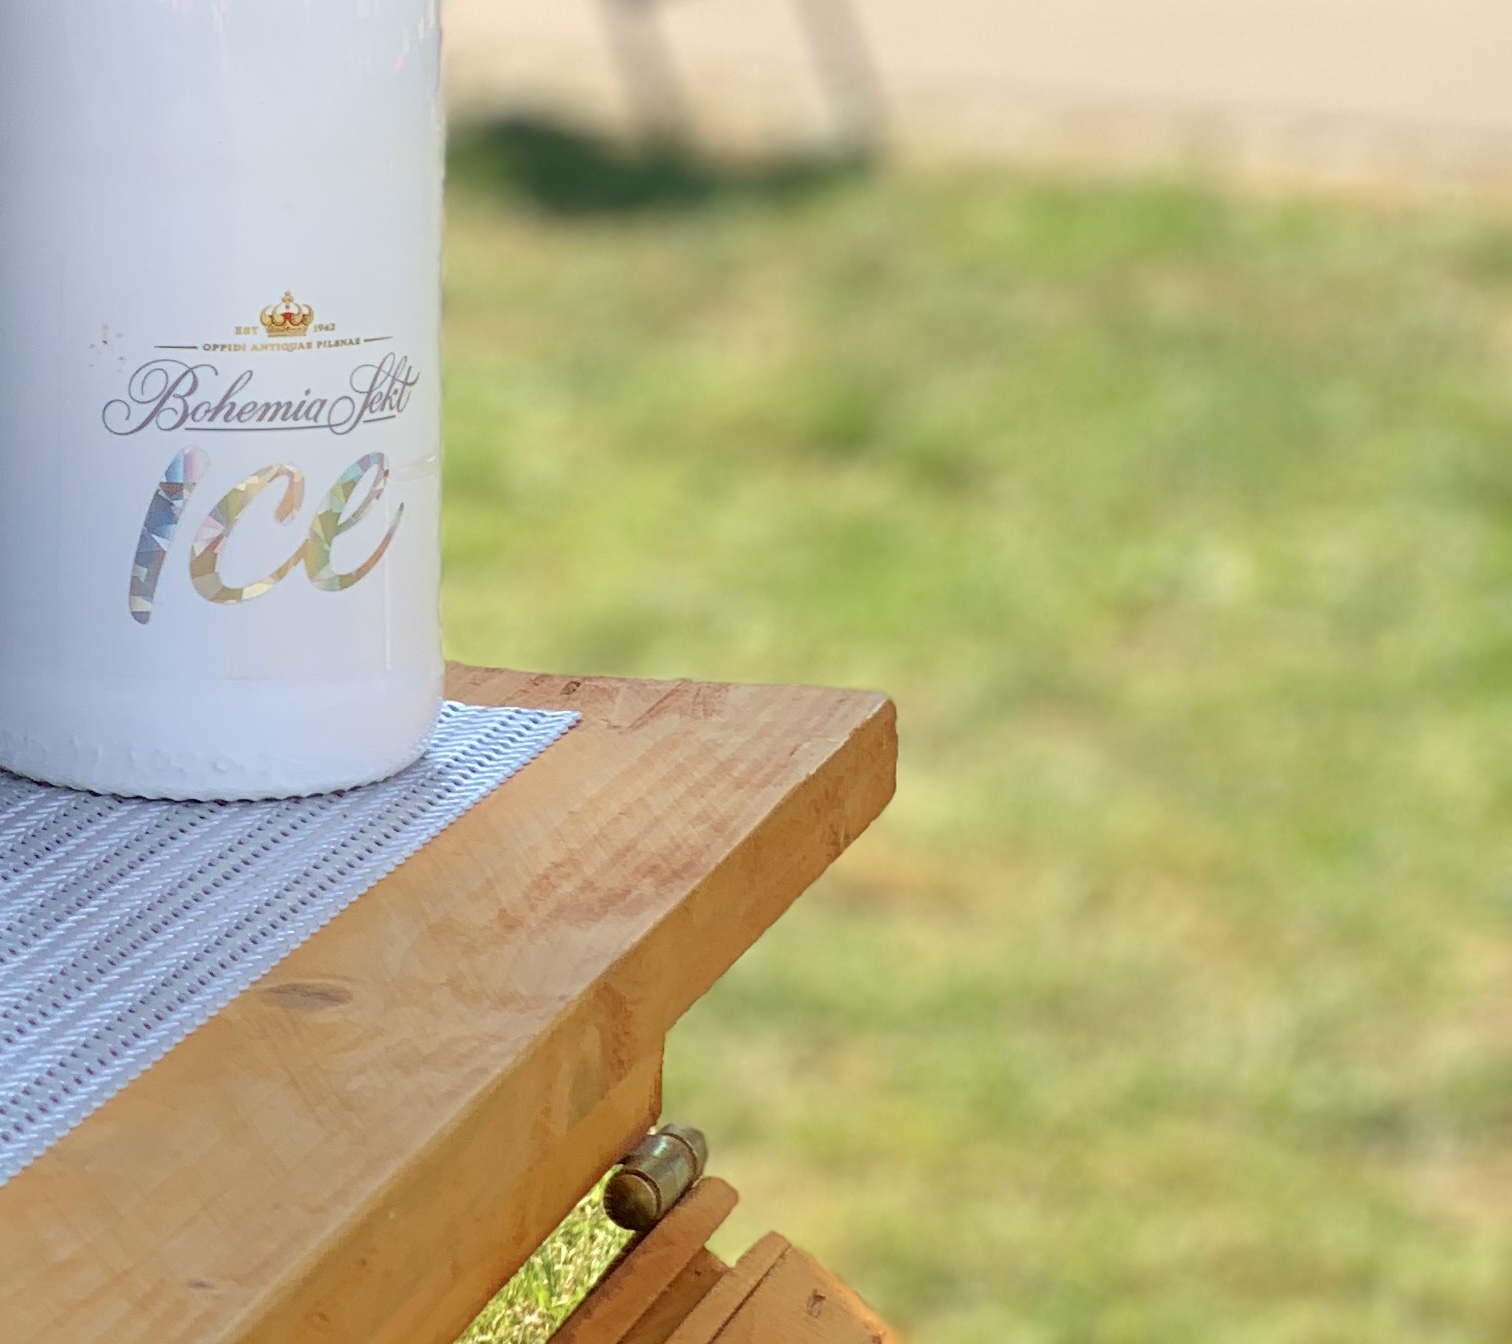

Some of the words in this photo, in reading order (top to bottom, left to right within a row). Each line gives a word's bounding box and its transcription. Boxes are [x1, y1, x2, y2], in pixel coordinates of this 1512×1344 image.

[235, 326, 259, 335] EST
[202, 343, 247, 352] OPPIDI
[102, 359, 327, 435] Bohemia
[327, 352, 420, 435] Sekt
